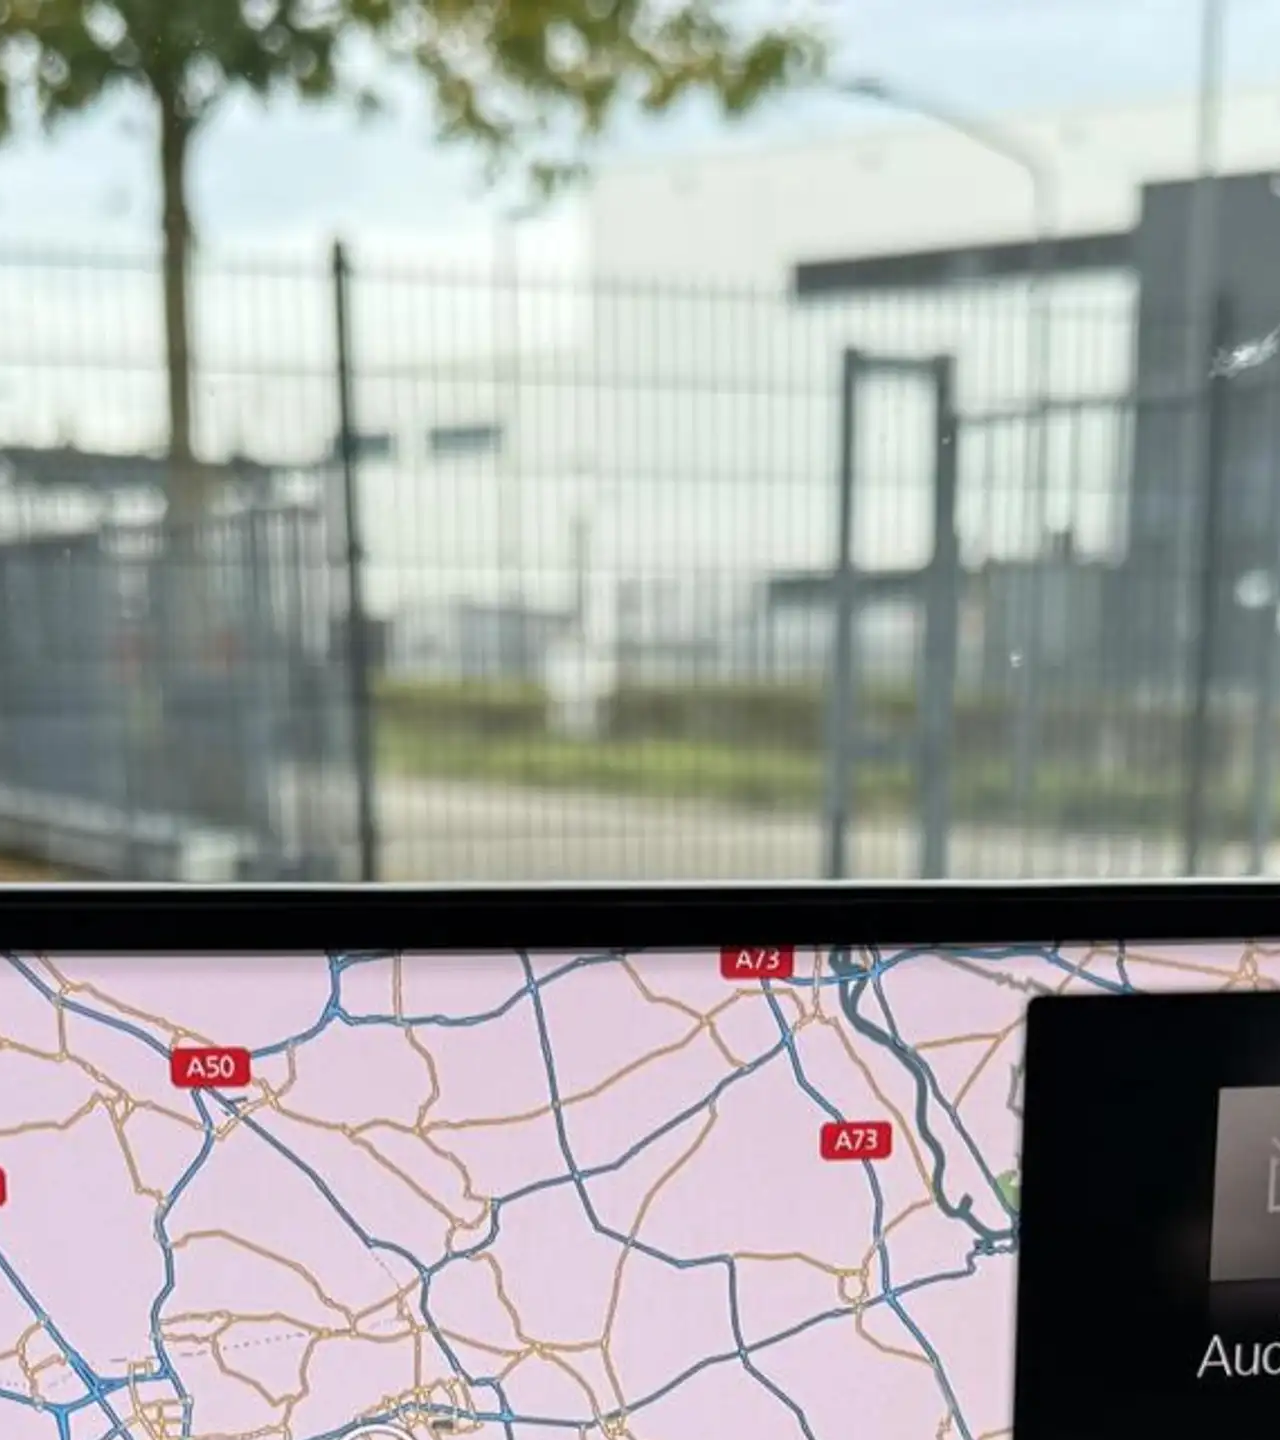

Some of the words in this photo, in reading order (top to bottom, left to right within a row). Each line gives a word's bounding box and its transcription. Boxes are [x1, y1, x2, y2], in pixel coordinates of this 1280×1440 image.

[735, 947, 780, 970] A73
[186, 1054, 236, 1078] A50
[834, 1128, 879, 1151] A73
